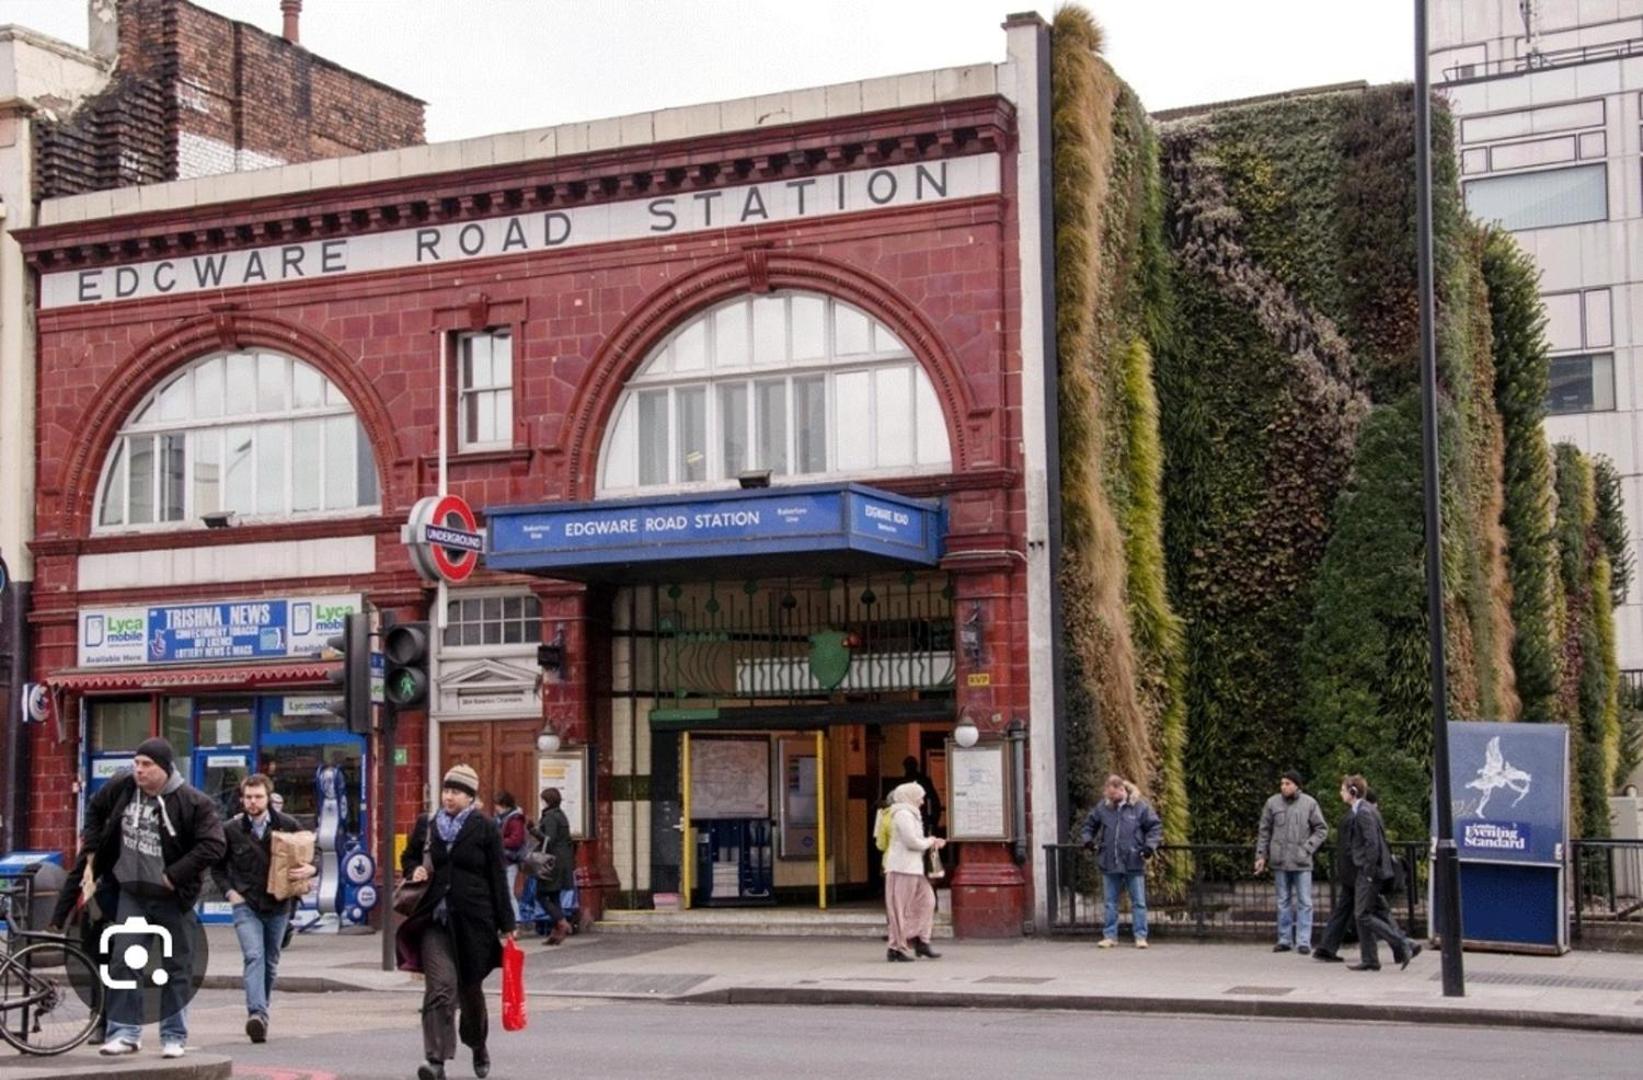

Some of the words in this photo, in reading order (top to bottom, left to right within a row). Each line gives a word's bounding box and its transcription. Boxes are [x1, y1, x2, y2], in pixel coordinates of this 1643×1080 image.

[416, 211, 572, 262] ROAD
[649, 161, 948, 232] STATION
[565, 518, 638, 537] EDGWARE
[645, 515, 688, 532] ROAD
[694, 511, 760, 529] STATION
[893, 511, 910, 526] ROAD
[427, 528, 481, 549] UNDERGROUND
[165, 606, 222, 630] TRISHNA
[229, 603, 271, 626] NEWS
[107, 616, 143, 634] Lyca
[107, 629, 143, 642] mobile
[86, 655, 120, 663] Available
[122, 654, 141, 662] Here
[1464, 825, 1518, 840] Evening
[1464, 837, 1525, 850] Standard
